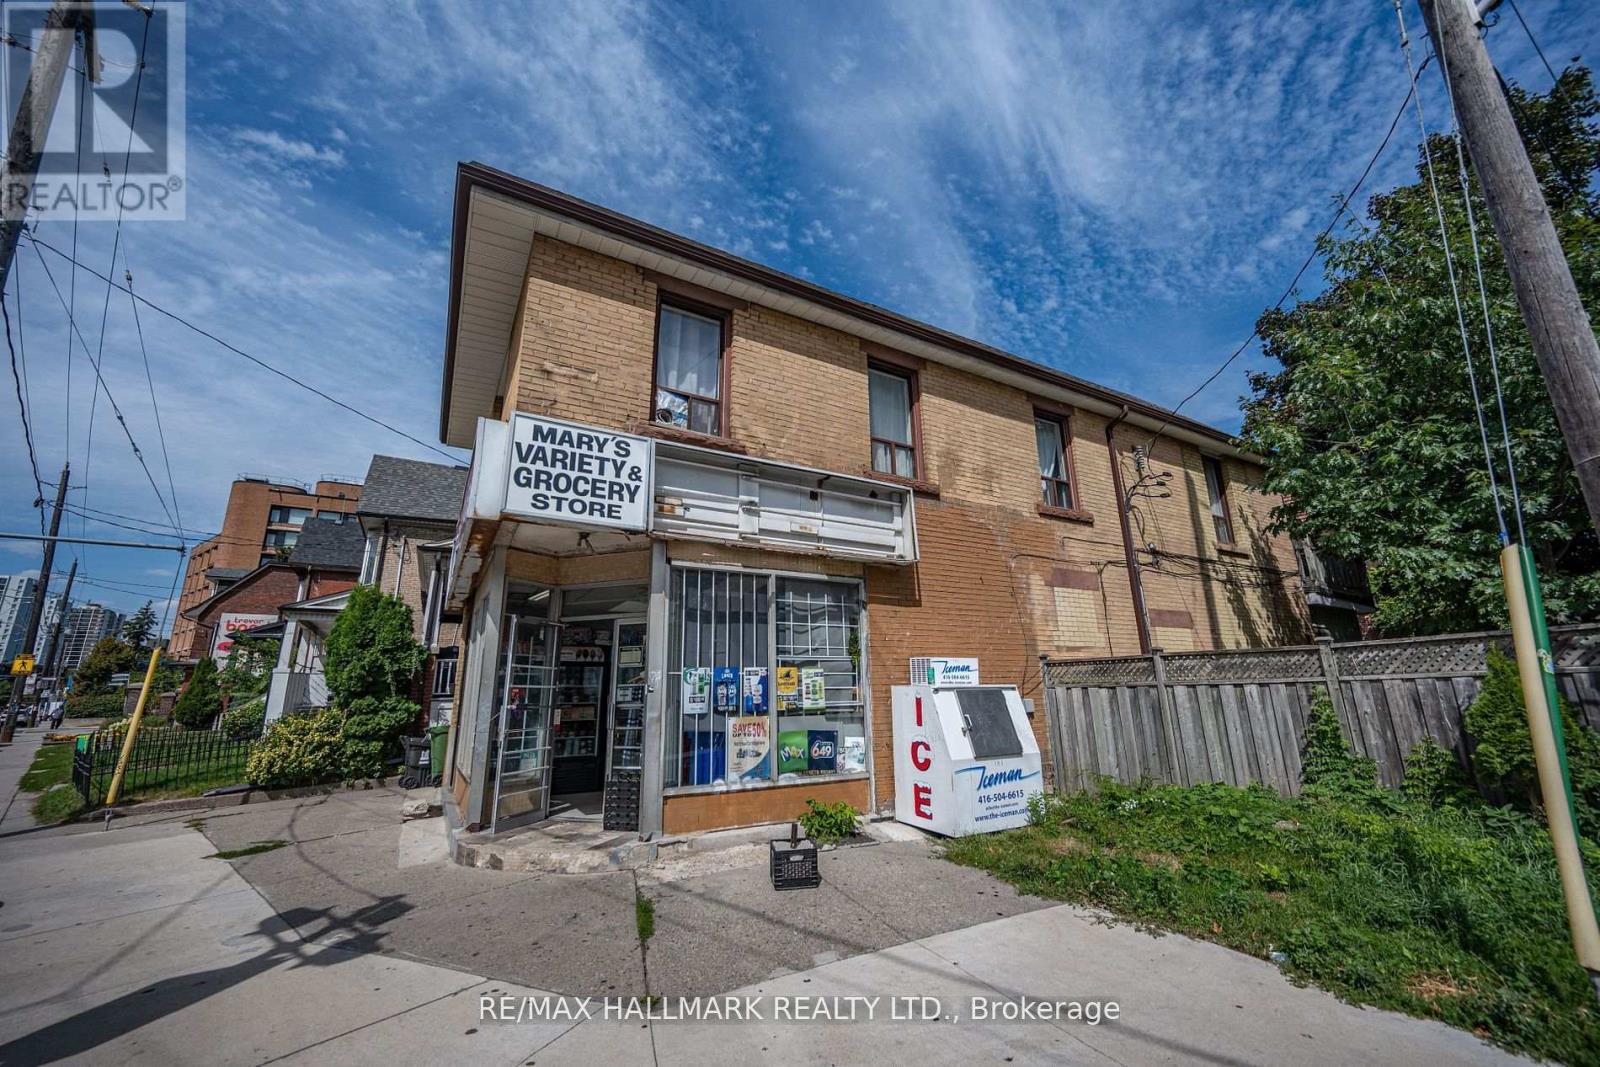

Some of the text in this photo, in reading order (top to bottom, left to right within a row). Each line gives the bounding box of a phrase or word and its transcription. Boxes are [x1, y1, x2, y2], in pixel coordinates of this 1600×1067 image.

[532, 424, 631, 458] MARY'S
[515, 441, 643, 482] VARIETY &
[513, 466, 641, 504] GROCERY
[530, 493, 622, 520] STORE
[930, 660, 978, 674] Iceman
[732, 722, 767, 738] SAVE 50%
[911, 696, 933, 821] ICE
[955, 766, 1040, 791] Iceman
[978, 789, 1024, 804] 416-504-6615
